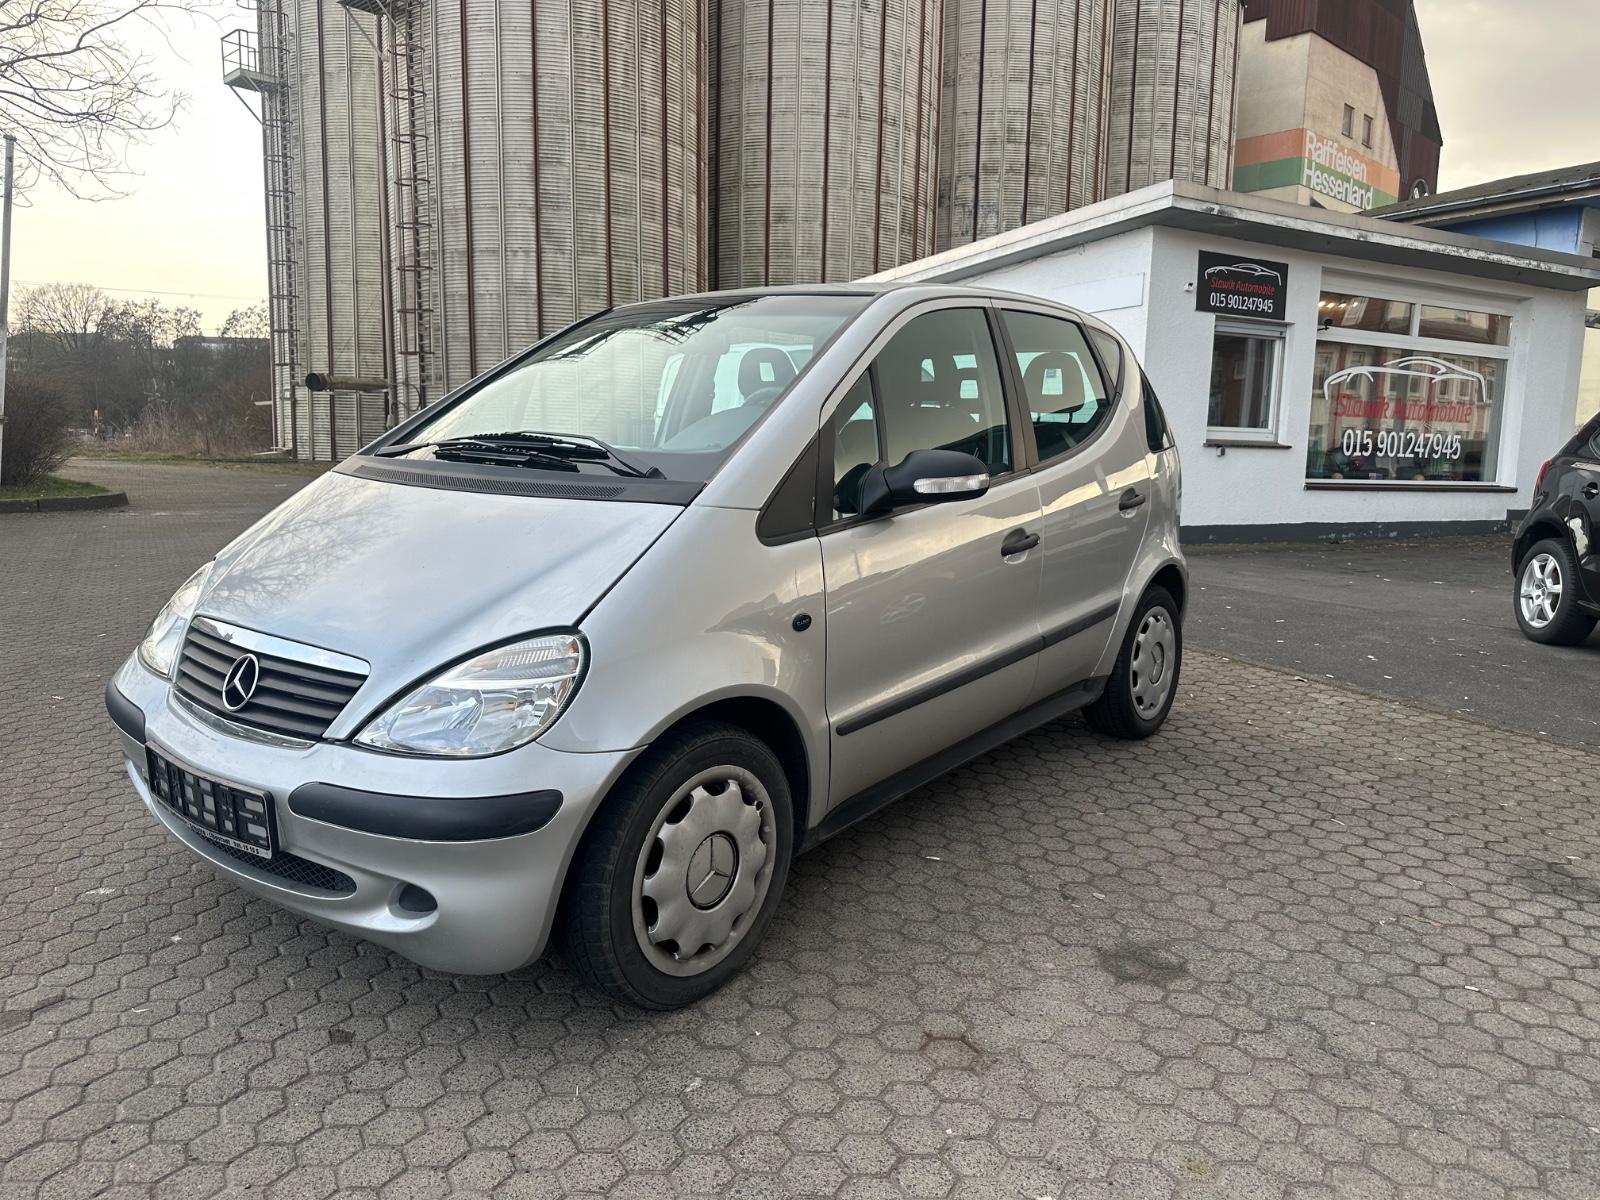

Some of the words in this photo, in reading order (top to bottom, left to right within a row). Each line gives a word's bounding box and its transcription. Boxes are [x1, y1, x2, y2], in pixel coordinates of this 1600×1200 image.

[1305, 129, 1367, 183] Raiffeisen
[1303, 159, 1374, 210] Hessenland
[1210, 292, 1226, 307] 015
[1227, 294, 1273, 312] 901247945
[1236, 281, 1275, 295] Automobile
[1392, 398, 1473, 423] Automobile
[1343, 429, 1373, 456] 015
[1376, 431, 1461, 460] 901247945
